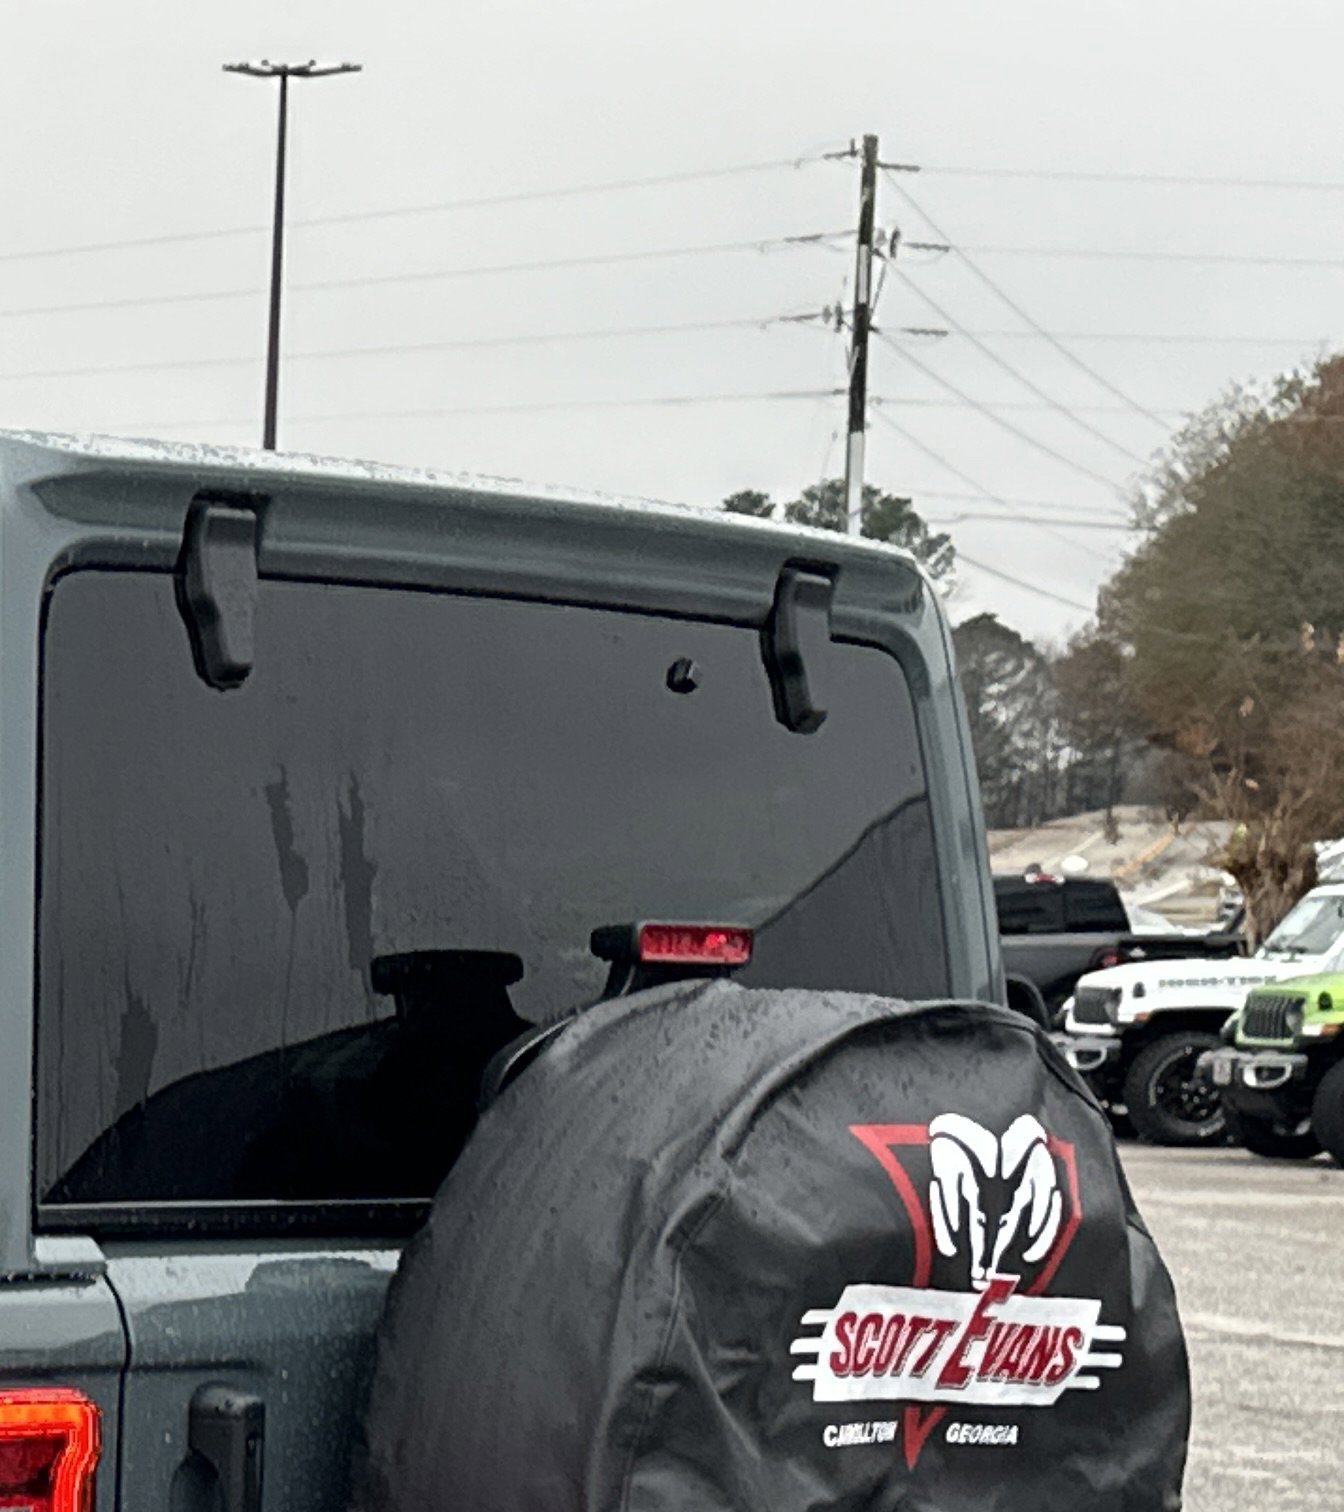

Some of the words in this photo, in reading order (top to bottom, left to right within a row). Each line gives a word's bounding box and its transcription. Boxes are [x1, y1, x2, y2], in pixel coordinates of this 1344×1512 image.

[829, 1311, 960, 1378] SCOTT
[935, 1277, 1085, 1390] EVANS
[946, 1422, 1018, 1445] GEORGIA
